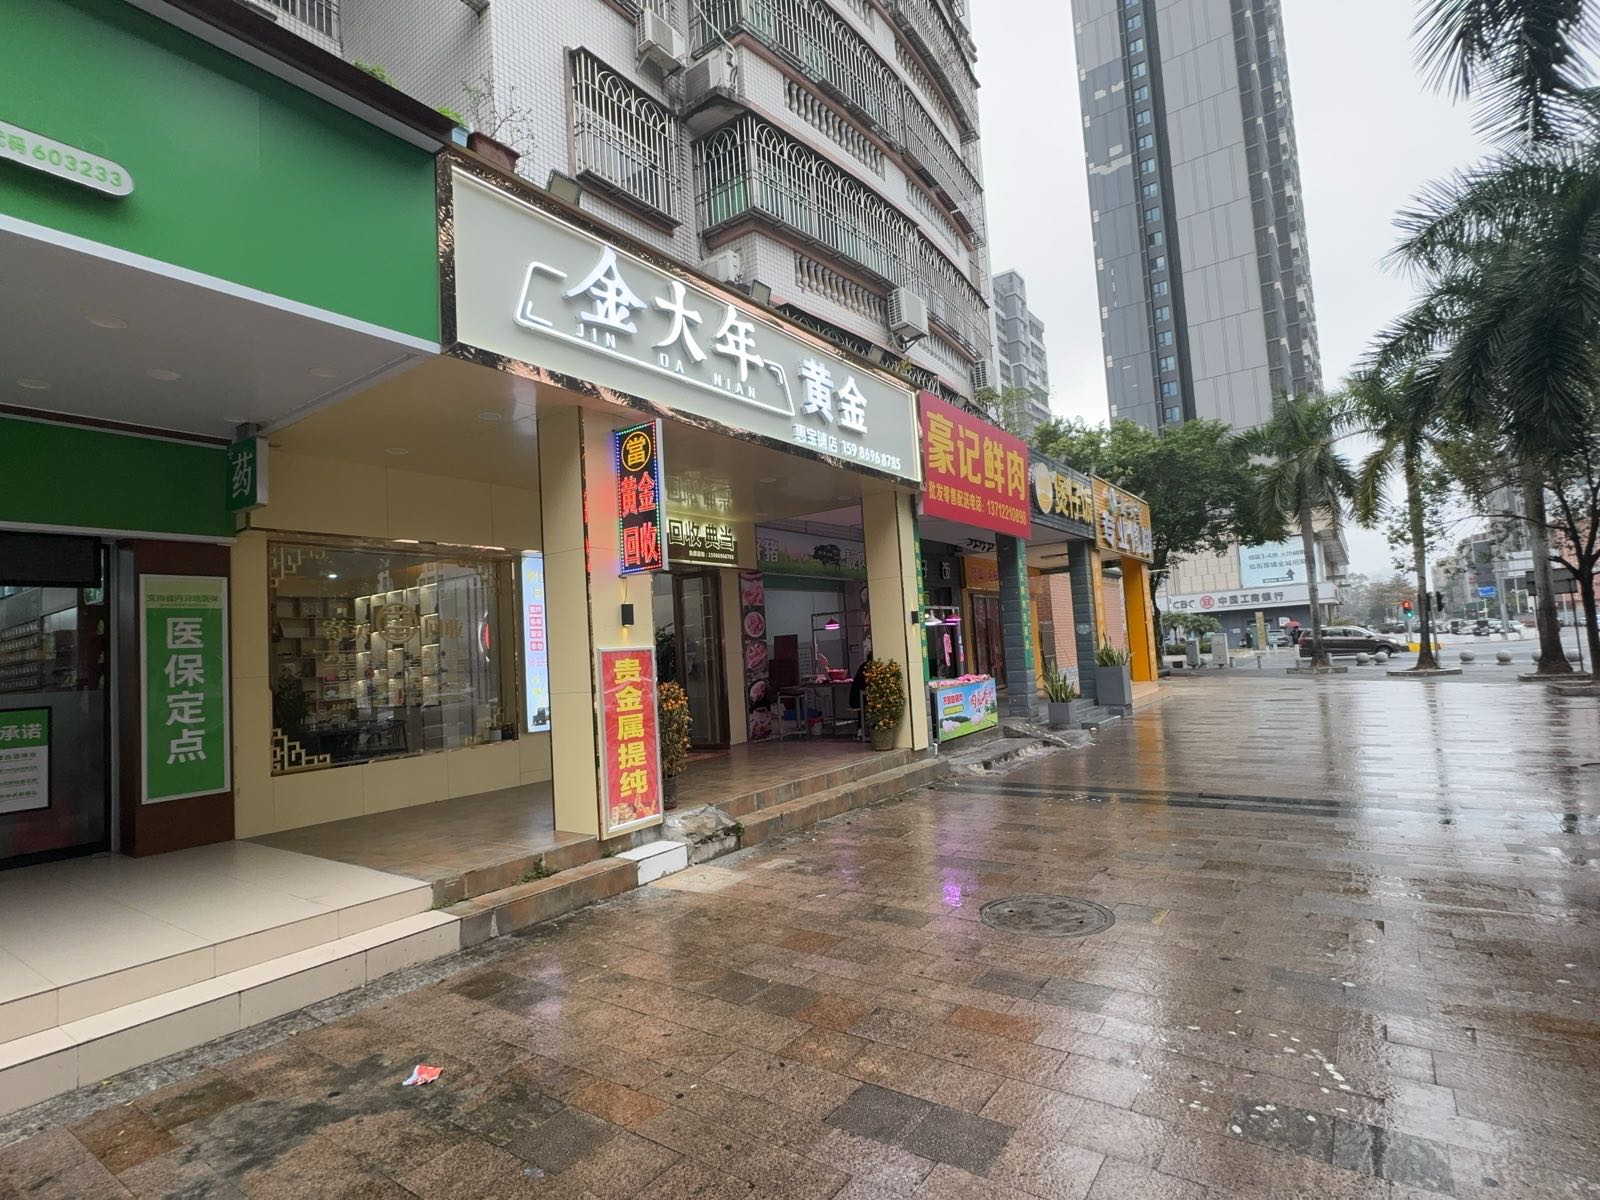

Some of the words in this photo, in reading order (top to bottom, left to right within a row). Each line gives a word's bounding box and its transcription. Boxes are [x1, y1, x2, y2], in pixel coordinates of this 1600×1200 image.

[32, 144, 122, 187] 603233
[563, 246, 764, 383] 金大年
[575, 323, 617, 348] JIN
[660, 352, 684, 373] DA
[714, 373, 757, 399] NIAN
[797, 358, 867, 434] 黄金
[232, 452, 253, 498] 药
[927, 411, 1026, 500] 豪记鲜肉
[623, 522, 658, 567] 回收
[668, 519, 702, 548] 回收
[705, 523, 735, 552] 典当
[1217, 592, 1284, 606] 中国工商银行
[164, 617, 206, 765] 医保定点
[613, 658, 649, 798] 贵金属提纯
